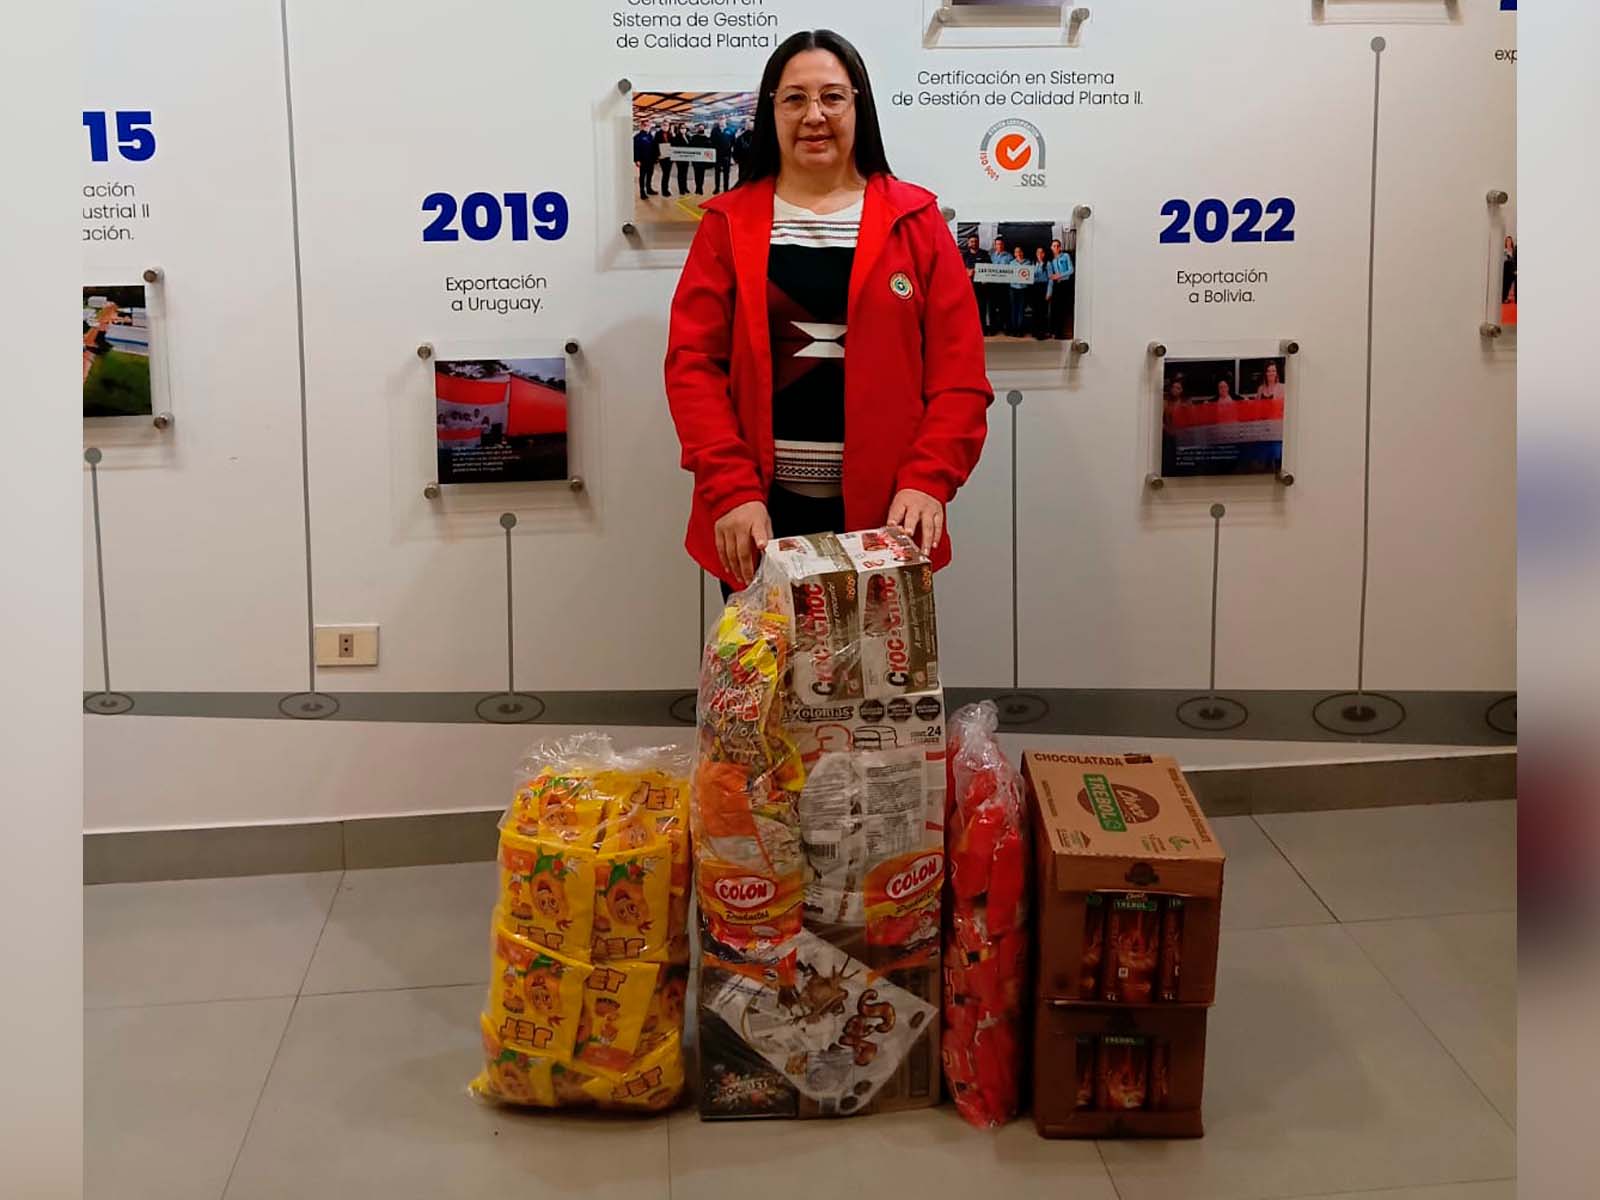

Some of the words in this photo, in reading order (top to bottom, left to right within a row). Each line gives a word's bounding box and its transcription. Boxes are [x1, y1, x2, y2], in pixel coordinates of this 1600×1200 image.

[613, 12, 681, 27] Sistema
[686, 12, 709, 27] de
[714, 12, 778, 27] Gestión
[616, 34, 640, 48] de
[644, 33, 711, 48] Calidad
[716, 33, 769, 48] Planta
[917, 70, 1021, 85] Certificación
[1025, 73, 1046, 85] en
[1050, 70, 1115, 85] Sistema
[892, 91, 913, 105] de
[918, 91, 980, 105] Gestión
[985, 91, 1006, 105] de
[1010, 91, 1075, 105] Calidad
[1079, 91, 1129, 105] Planta
[1134, 91, 1143, 105] II.
[83, 111, 156, 162] 15
[1020, 173, 1046, 187] SGS
[83, 182, 135, 197] ación
[421, 191, 569, 242] 2019
[1159, 197, 1296, 244] 2022
[446, 274, 547, 294] Exportación
[1176, 268, 1268, 287] Exportación
[1188, 292, 1199, 303] a
[1204, 289, 1256, 303] Bolivia.
[451, 300, 463, 311] a
[468, 297, 544, 314] Uruguay.
[927, 725, 942, 737] 24
[1034, 753, 1124, 766] CHOCOLATADA
[891, 857, 938, 896] COLON
[719, 883, 768, 900] COLON
